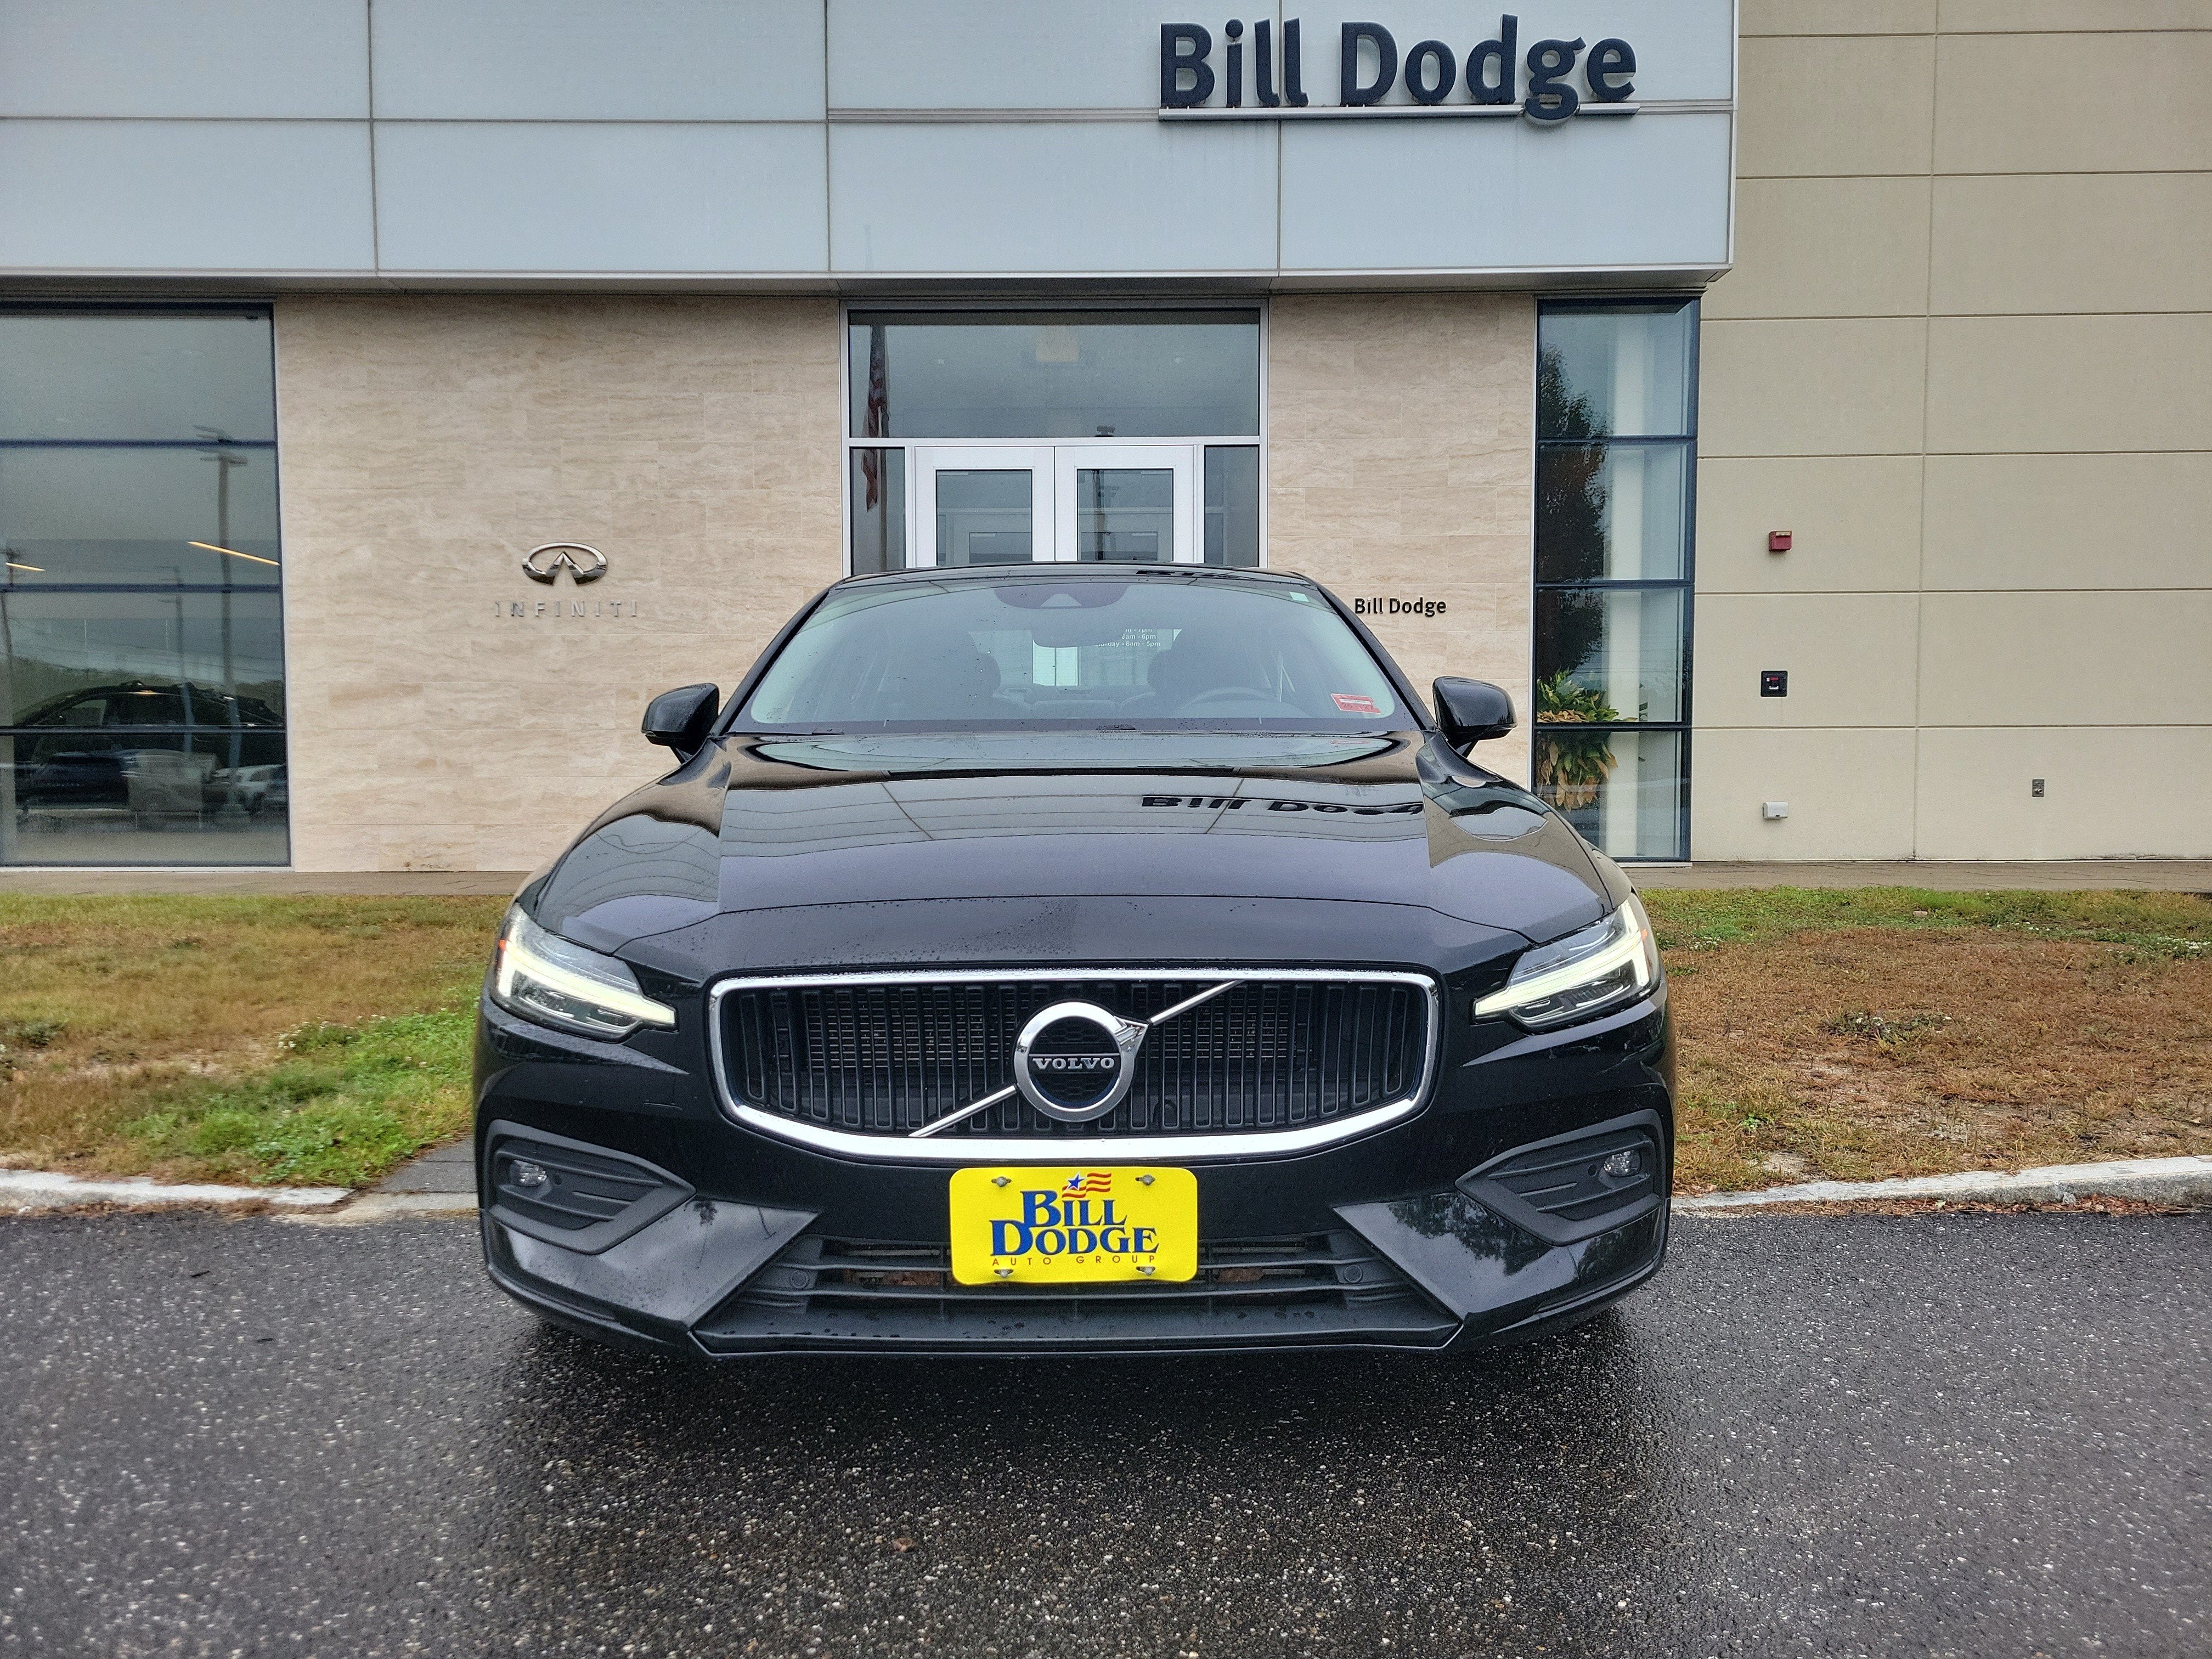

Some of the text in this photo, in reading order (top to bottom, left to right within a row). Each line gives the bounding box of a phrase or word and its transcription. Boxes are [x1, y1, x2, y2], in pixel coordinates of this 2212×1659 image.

[1160, 14, 1637, 124] Bill Dodge
[495, 600, 637, 617] INFINITI
[1355, 597, 1447, 618] Bill Dodge
[1032, 1058, 1115, 1070] VOLVO
[1020, 1189, 1127, 1228] BILL
[989, 1219, 1159, 1256] DODGE
[992, 1255, 1155, 1266] AUTO GROUP
